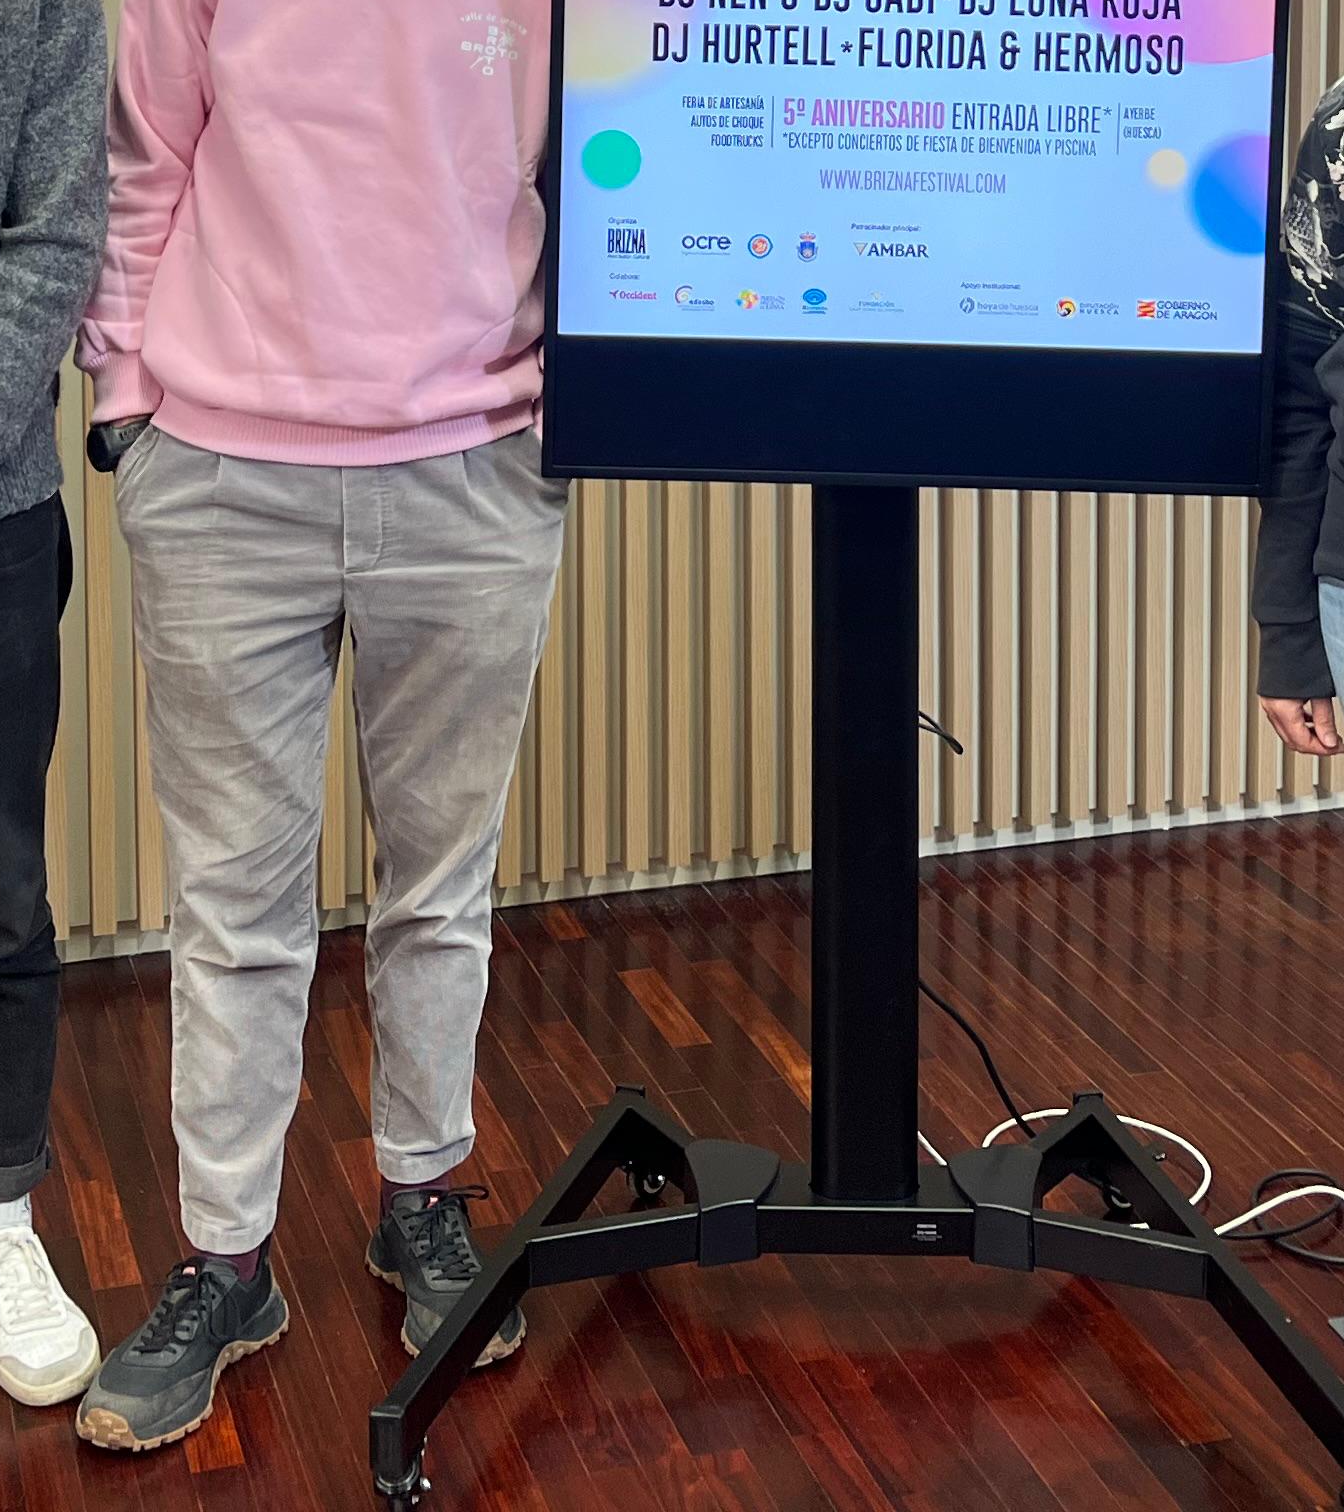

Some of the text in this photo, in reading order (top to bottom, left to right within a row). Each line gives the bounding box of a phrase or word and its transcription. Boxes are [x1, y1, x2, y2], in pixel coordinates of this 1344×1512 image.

[651, 22, 1184, 76] DJ HURTELL FLORIDA & HERMOSO
[682, 96, 705, 109] FERIA
[708, 97, 718, 109] DE
[691, 115, 716, 127] AUTOS
[719, 116, 730, 128] DE
[811, 99, 945, 129] ANIVERSARIO
[952, 102, 1039, 132] ENTRADA
[838, 134, 903, 151] CONCIERTOS
[907, 135, 920, 151] DE
[923, 136, 958, 153] FIESTA
[961, 137, 974, 153] DE
[978, 137, 1041, 155] BIENVENIDA
[1046, 139, 1052, 155] Y
[1056, 139, 1096, 156] PISCINA
[819, 169, 1006, 194] WWW.BRIZNAFESTIVAL.COM
[607, 228, 646, 254] BRIZNA
[681, 235, 731, 250] ocre
[867, 242, 929, 258] AMBAR
